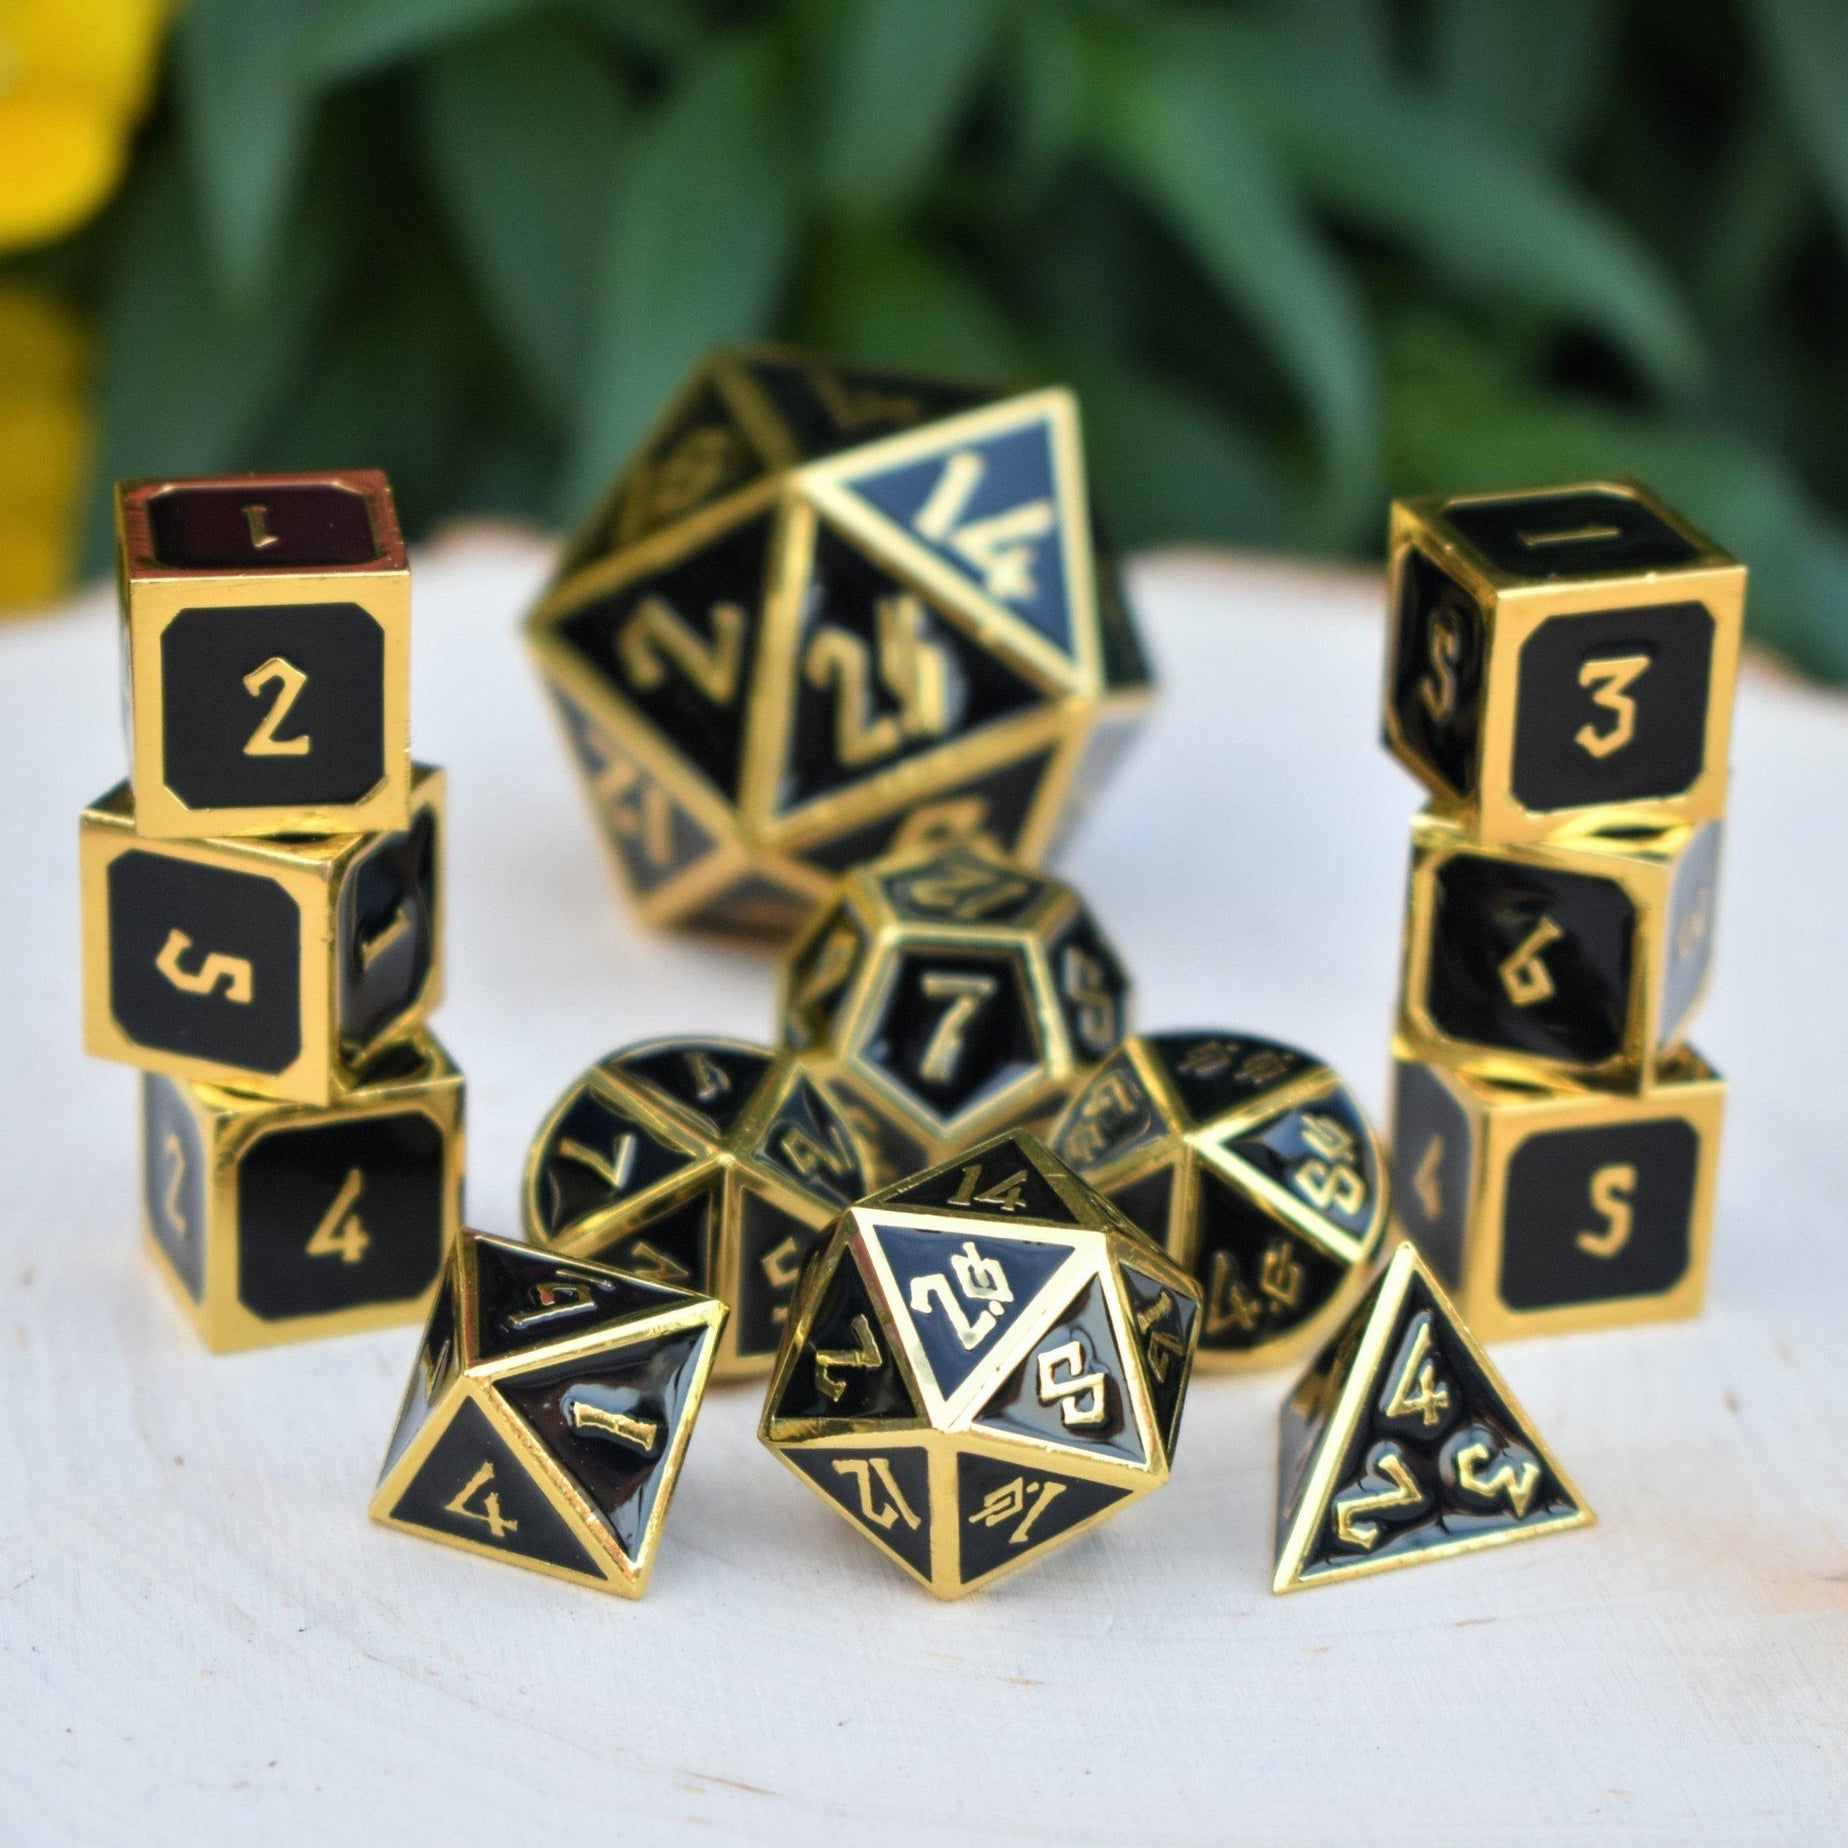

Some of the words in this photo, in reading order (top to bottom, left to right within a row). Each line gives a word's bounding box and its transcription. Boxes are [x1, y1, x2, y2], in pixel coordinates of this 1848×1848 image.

[242, 505, 279, 549] 1
[242, 656, 310, 757] 2
[1573, 653, 1652, 759] 3
[154, 927, 253, 1005] 5
[1500, 915, 1565, 1006] 6
[921, 972, 997, 1083] 7
[304, 1167, 372, 1264] 4
[947, 1164, 1028, 1213] 14
[1576, 1163, 1638, 1259] 5
[909, 1240, 1015, 1352] 20
[814, 1312, 884, 1403] 2
[1035, 1340, 1106, 1427] 8
[1386, 1322, 1449, 1426] 4
[572, 1400, 658, 1452] 1
[443, 1460, 519, 1538] 4
[831, 1457, 922, 1530] 12
[968, 1475, 1068, 1544] 10
[1335, 1453, 1422, 1549] 2
[1456, 1442, 1541, 1519] 3
